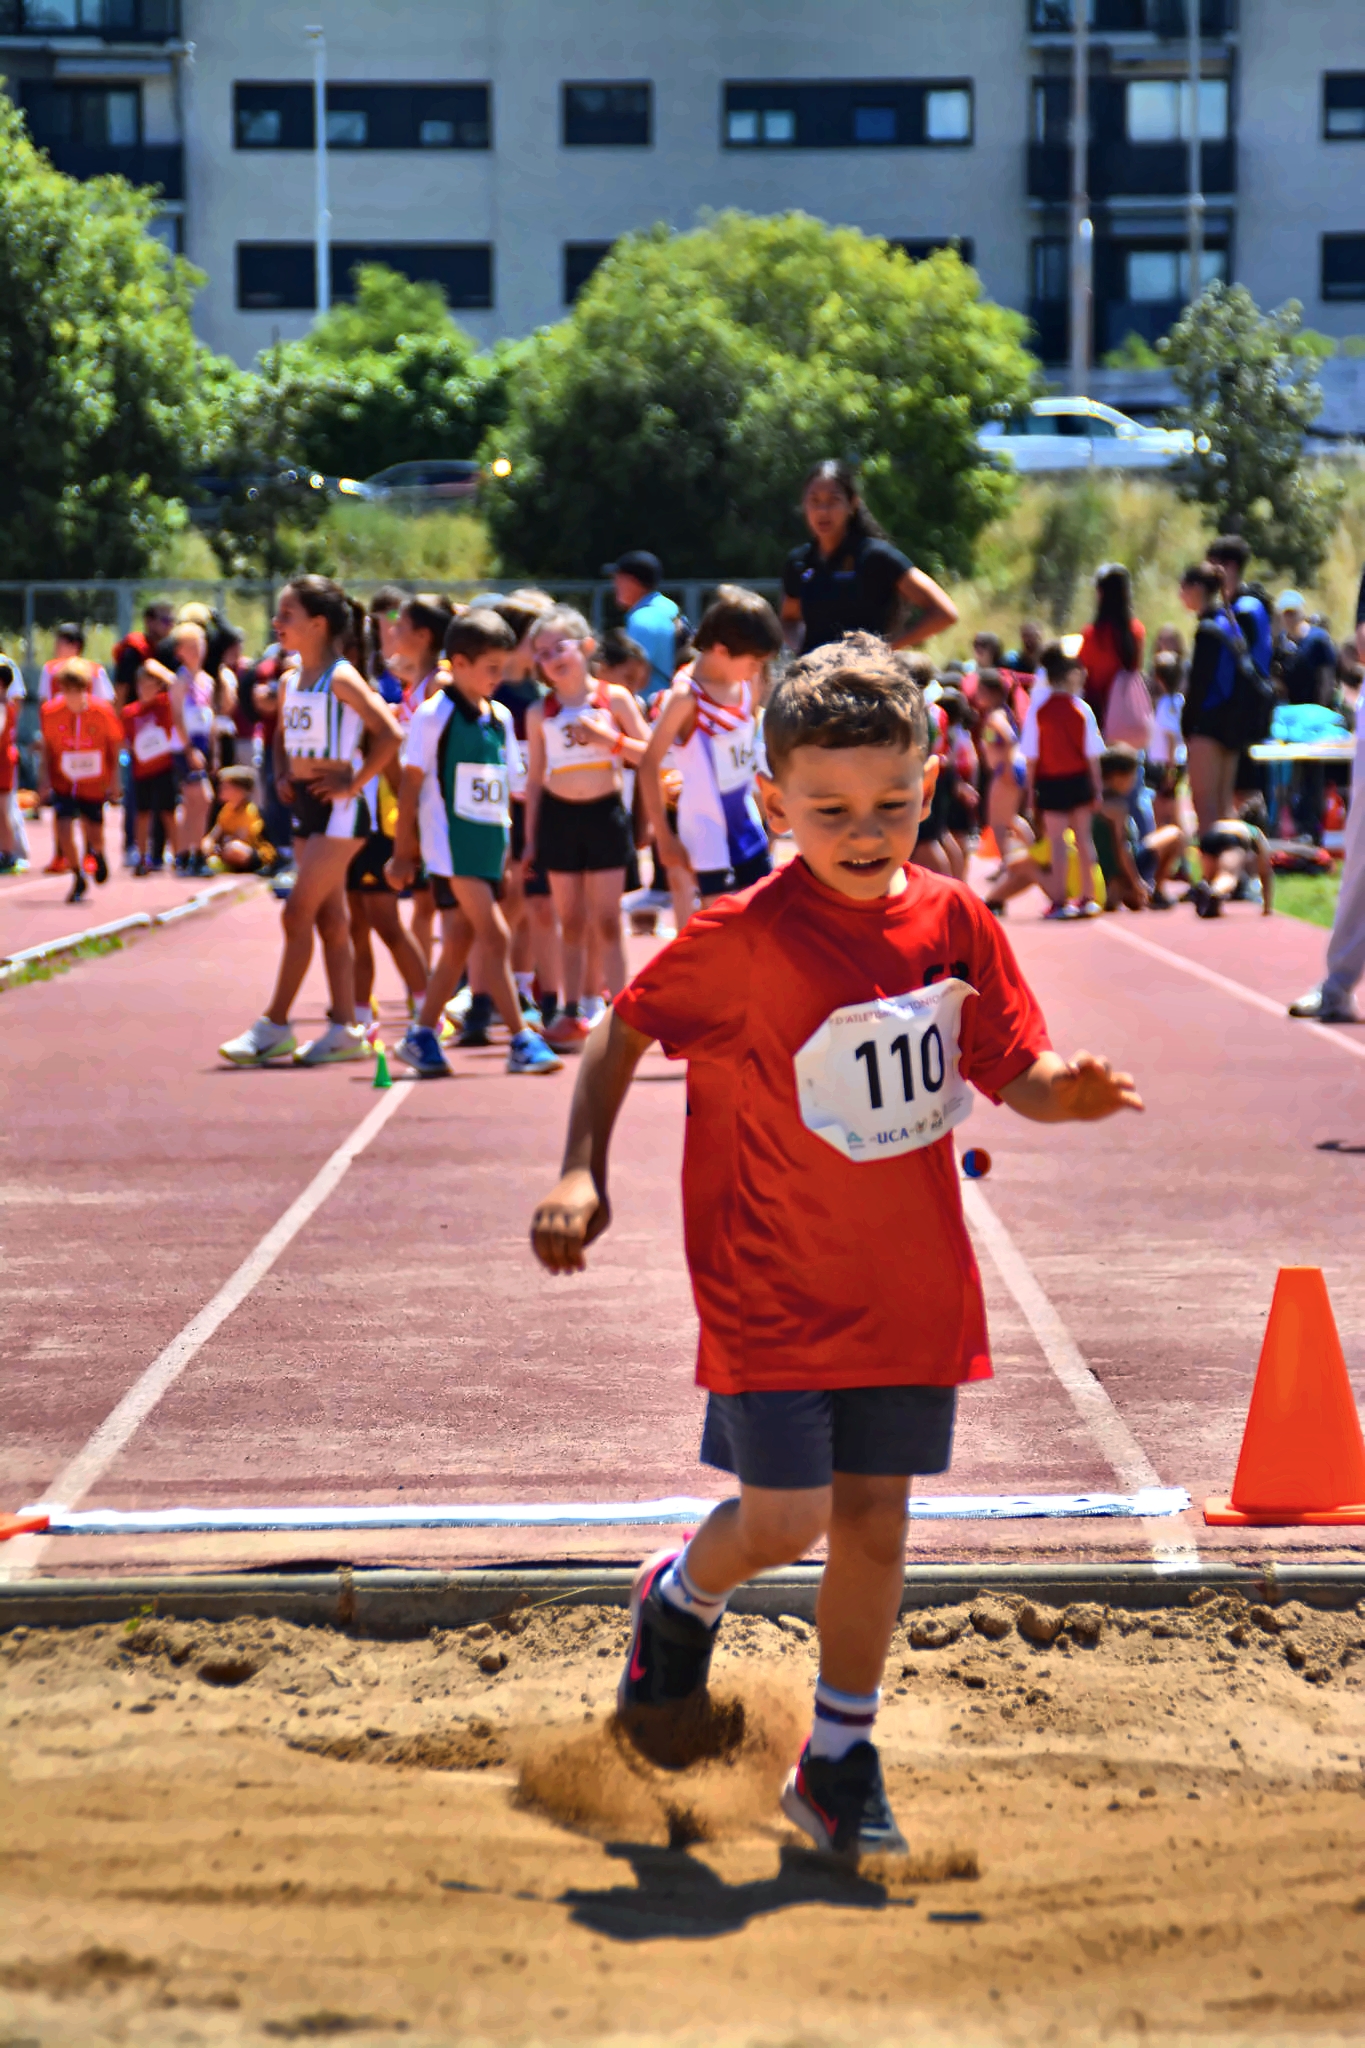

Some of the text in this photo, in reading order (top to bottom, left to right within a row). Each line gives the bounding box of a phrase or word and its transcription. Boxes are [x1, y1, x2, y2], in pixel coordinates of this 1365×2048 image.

[472, 777, 503, 803] 50
[855, 1023, 945, 1110] 110
[877, 1128, 909, 1144] UCA
